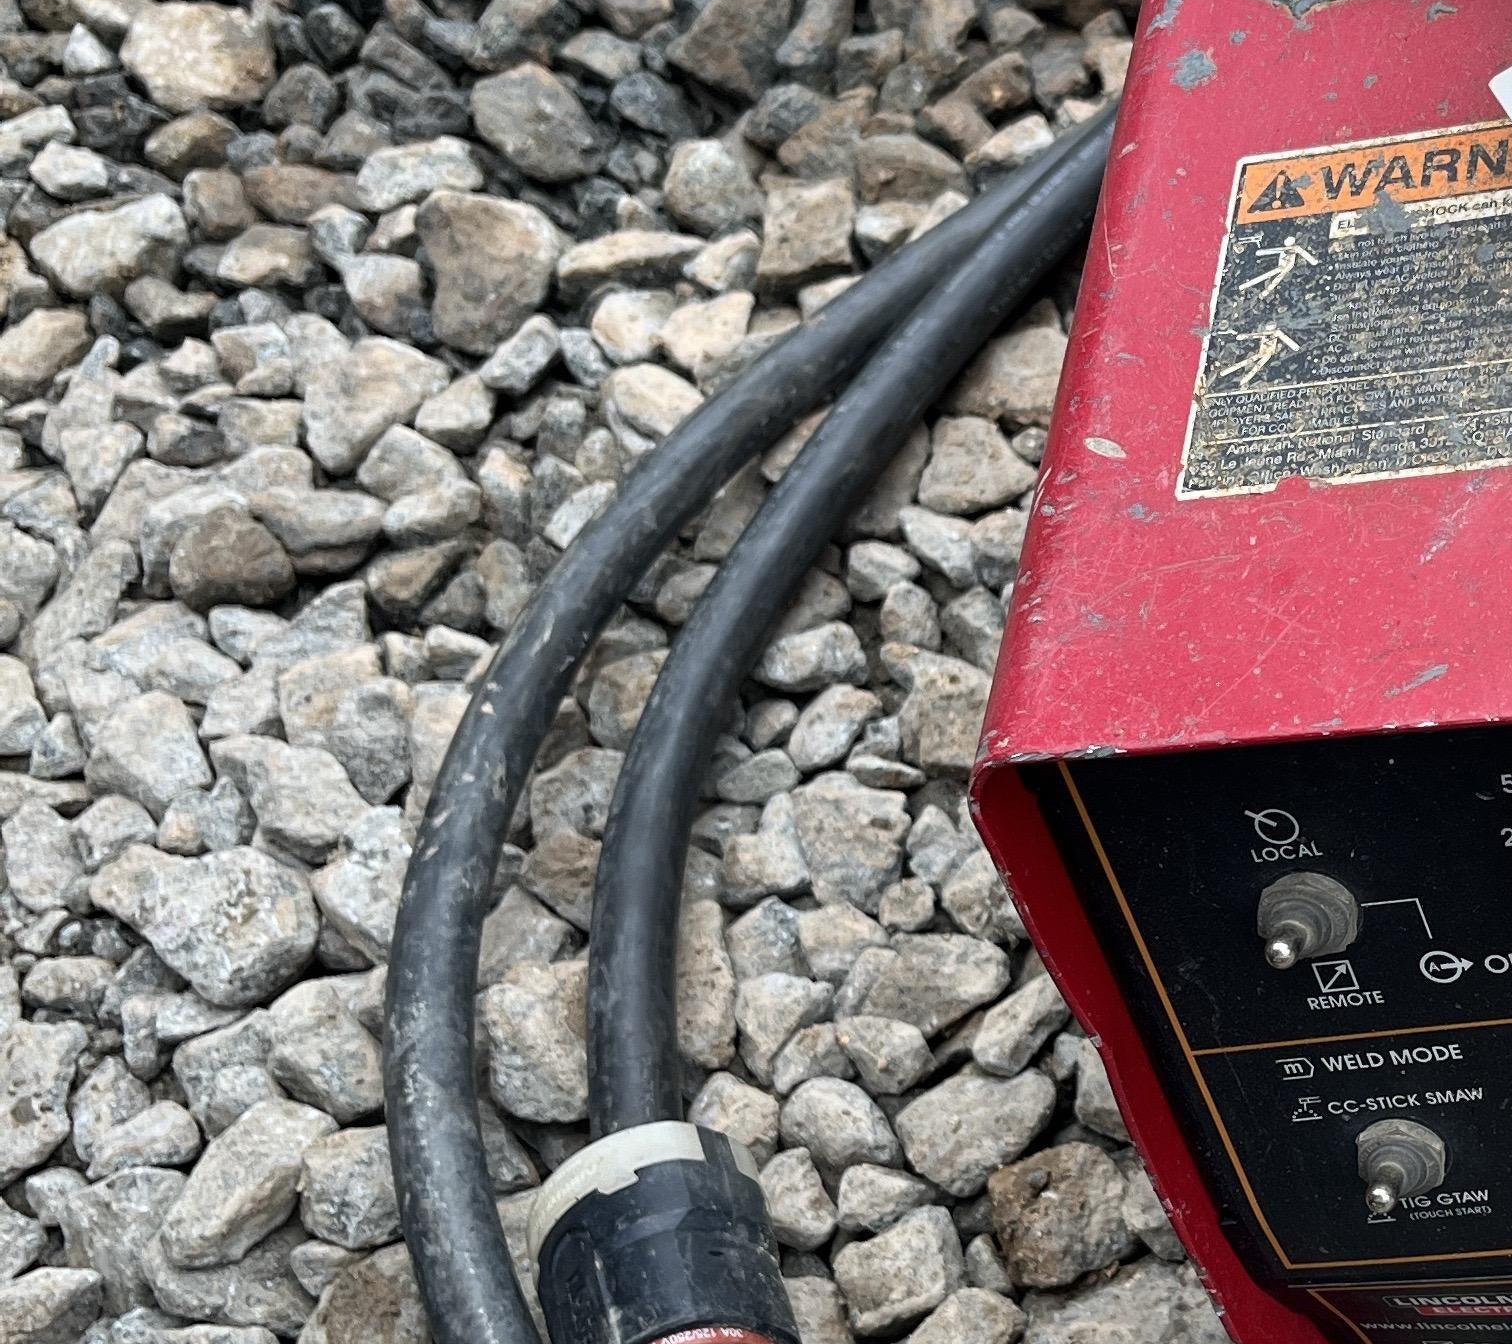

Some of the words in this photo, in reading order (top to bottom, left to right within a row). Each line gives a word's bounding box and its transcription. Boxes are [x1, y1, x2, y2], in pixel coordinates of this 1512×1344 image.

[1250, 840, 1323, 863] LOCAL
[1306, 990, 1385, 1010] REMOTE
[1320, 1052, 1384, 1072] WELD
[1388, 1043, 1463, 1065] MODE
[1327, 1093, 1421, 1114] CC-STICK
[1424, 1087, 1483, 1105] SMAW
[1398, 1195, 1431, 1209] TIG
[1436, 1189, 1488, 1205] GTAW
